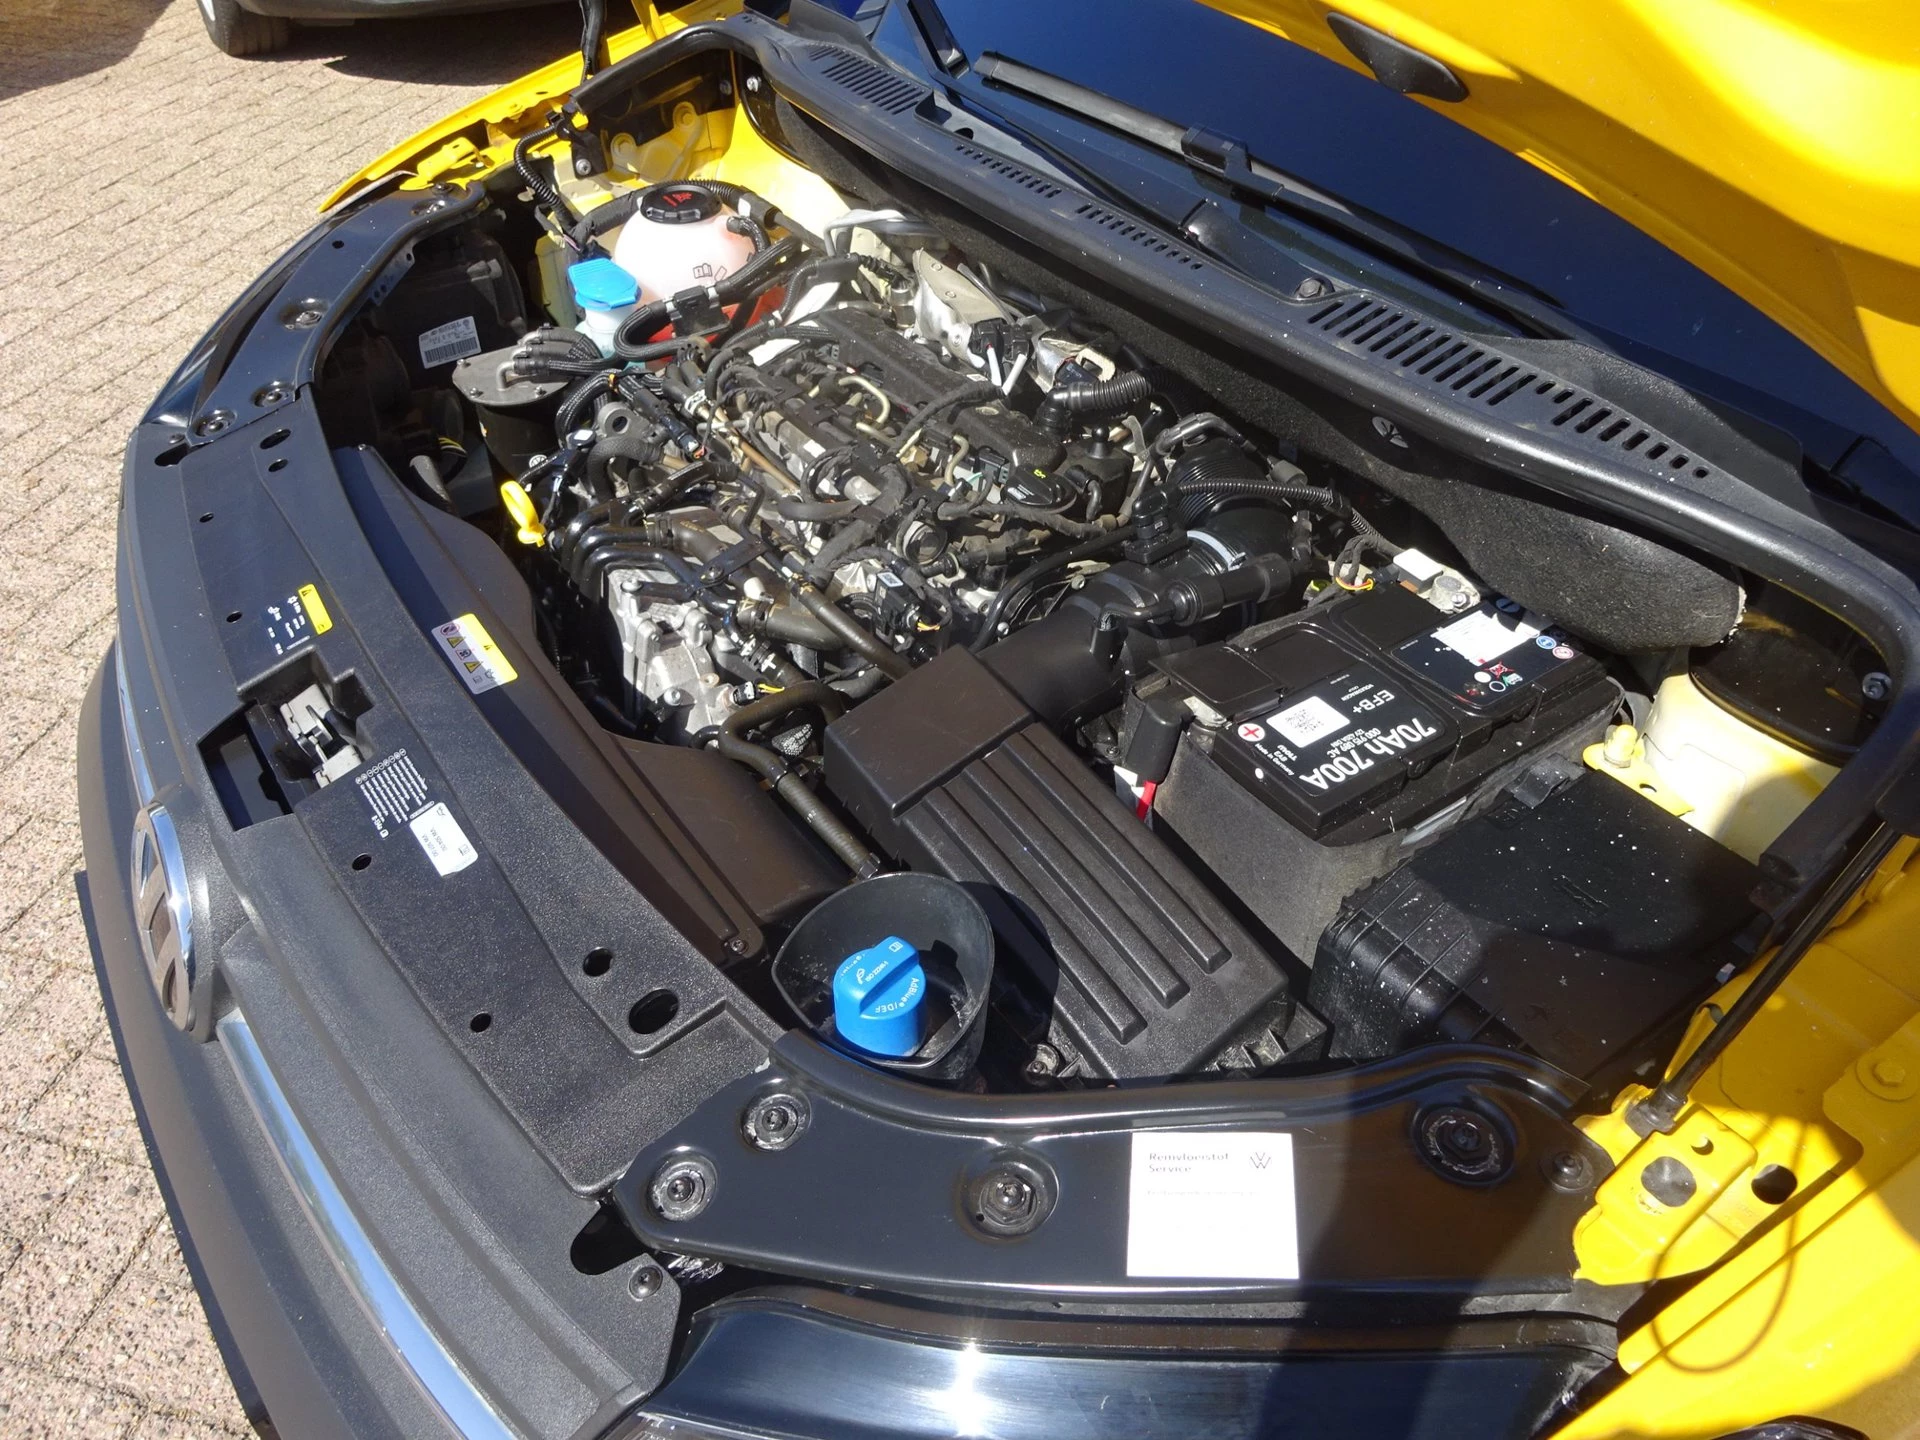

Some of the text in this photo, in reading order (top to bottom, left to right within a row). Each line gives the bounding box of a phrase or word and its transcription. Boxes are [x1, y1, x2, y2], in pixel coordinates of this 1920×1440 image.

[1353, 689, 1395, 713] EFB+
[1254, 743, 1268, 755] Made
[1272, 757, 1295, 776] Germany
[1299, 717, 1437, 790] 70Ah 700A
[1327, 747, 1340, 758] AC
[1148, 1163, 1192, 1173] Service
